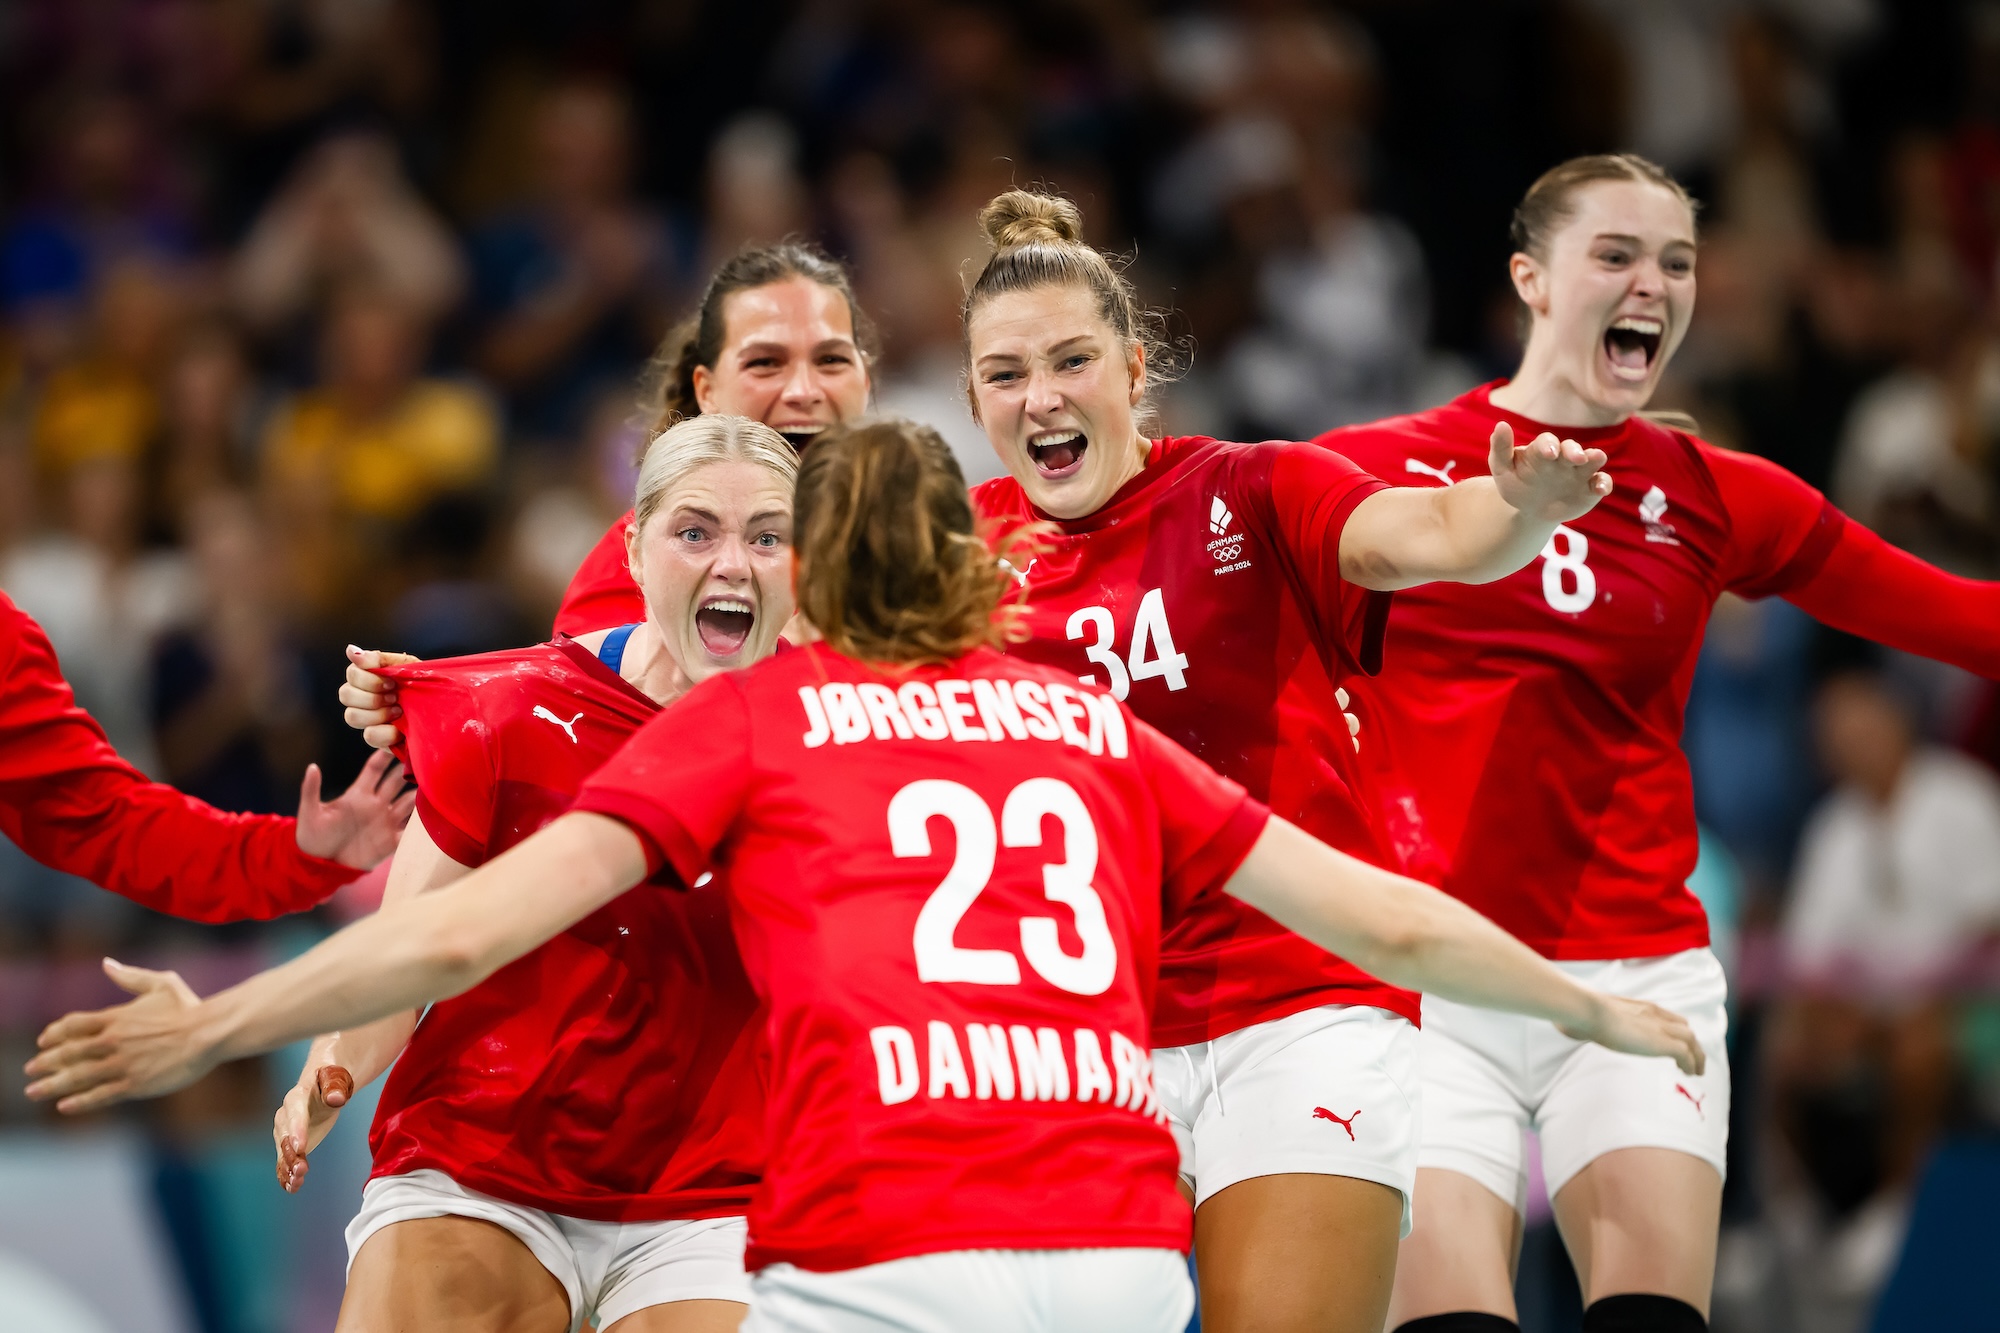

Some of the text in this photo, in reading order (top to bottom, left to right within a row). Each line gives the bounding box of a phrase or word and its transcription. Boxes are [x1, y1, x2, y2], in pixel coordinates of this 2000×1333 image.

[1206, 533, 1244, 551] DENMARK
[1214, 560, 1251, 576] PARIS 2024
[1540, 523, 1597, 613] 8
[1065, 587, 1189, 702] 34
[798, 679, 1129, 760] JØRGENSEN
[887, 777, 1118, 996] 23
